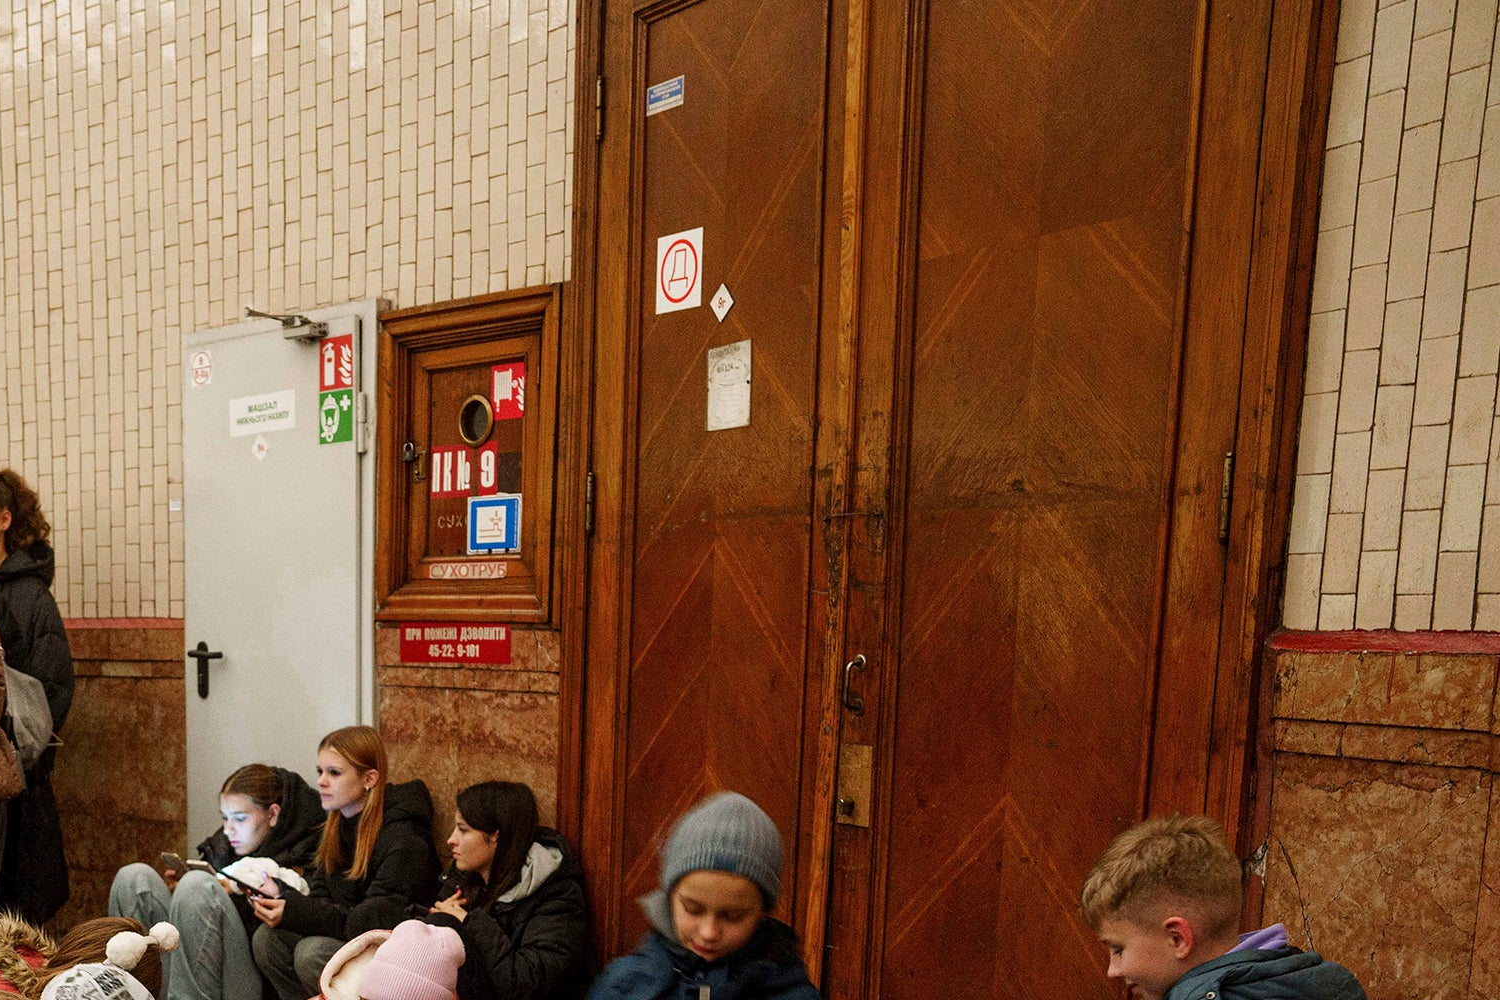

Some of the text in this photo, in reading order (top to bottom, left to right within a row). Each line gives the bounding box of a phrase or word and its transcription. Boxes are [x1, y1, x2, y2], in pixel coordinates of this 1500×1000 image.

[667, 248, 688, 291] Д
[431, 449, 495, 493] ПК № 9
[437, 514, 468, 529] СУХ
[430, 562, 507, 578] СУХОТРУБ
[405, 626, 506, 642] ПРИ ПОЖЕЖІ ДЗВОНИТИ
[428, 643, 480, 658] 45-22; 9-101
